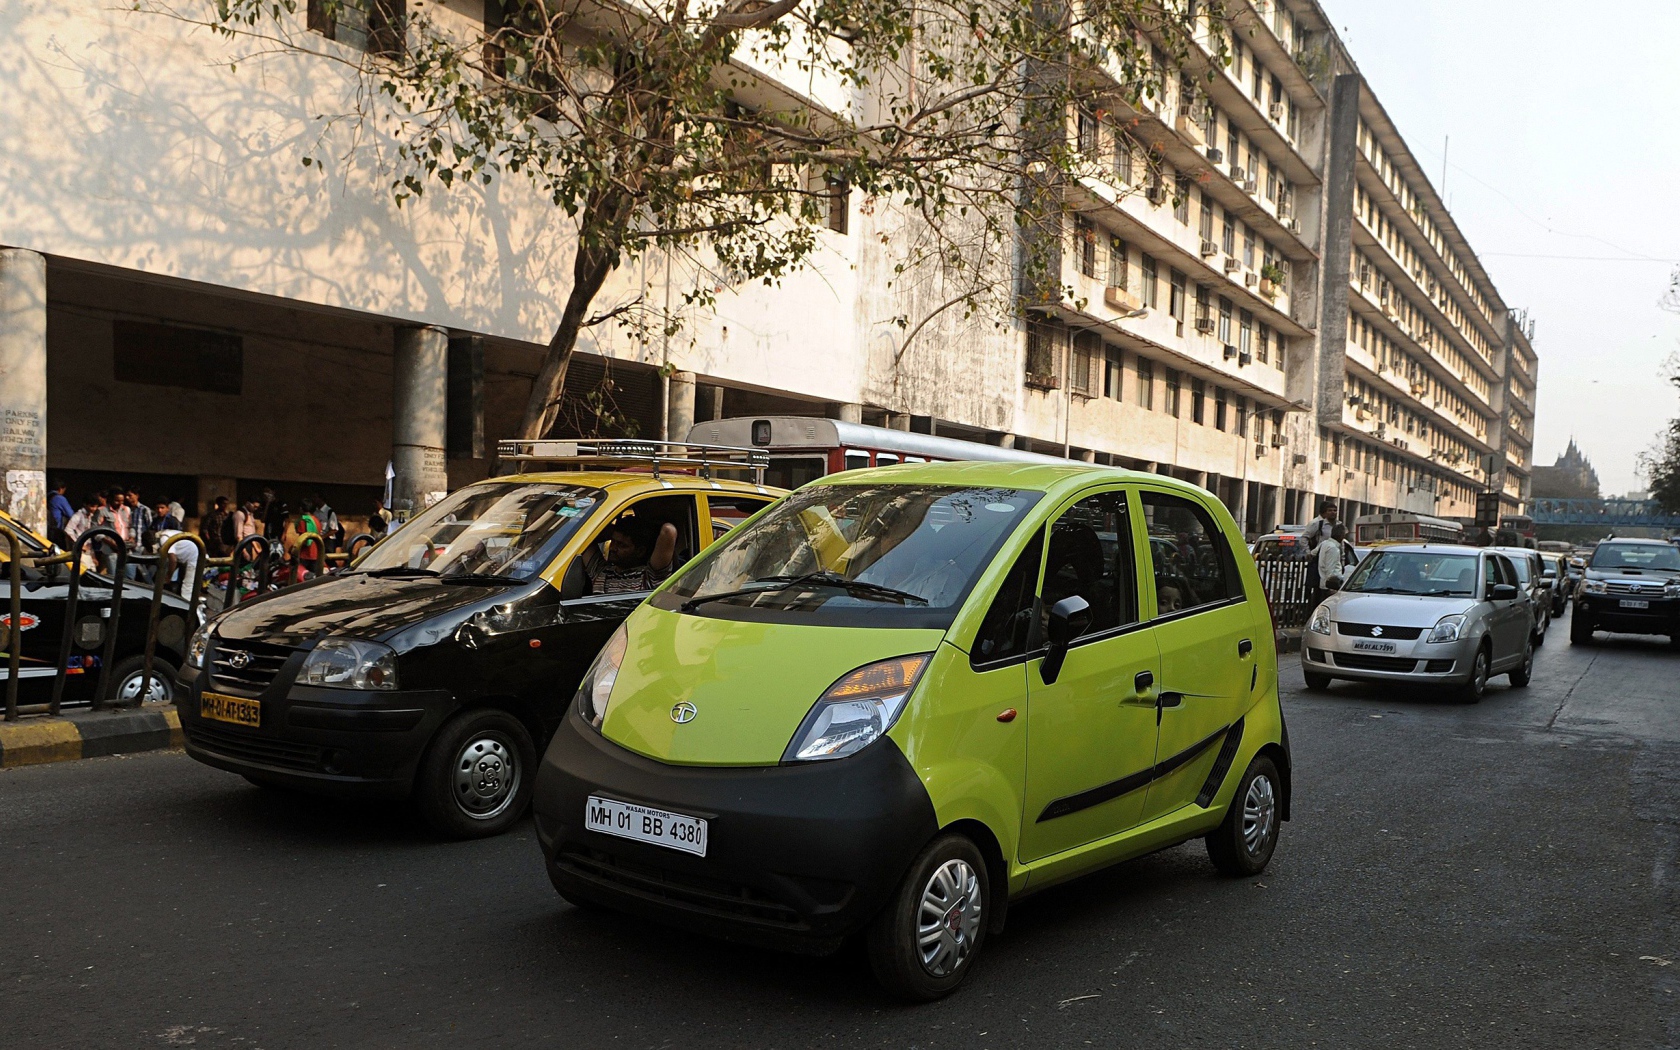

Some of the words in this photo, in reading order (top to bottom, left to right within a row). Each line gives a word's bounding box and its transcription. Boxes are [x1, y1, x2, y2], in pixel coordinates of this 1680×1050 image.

[591, 806, 612, 827] MH
[618, 812, 631, 831] 01
[642, 816, 663, 837] BB
[669, 822, 702, 846] 4380
[625, 805, 647, 815] WASAN
[646, 810, 671, 820] MOTORS
